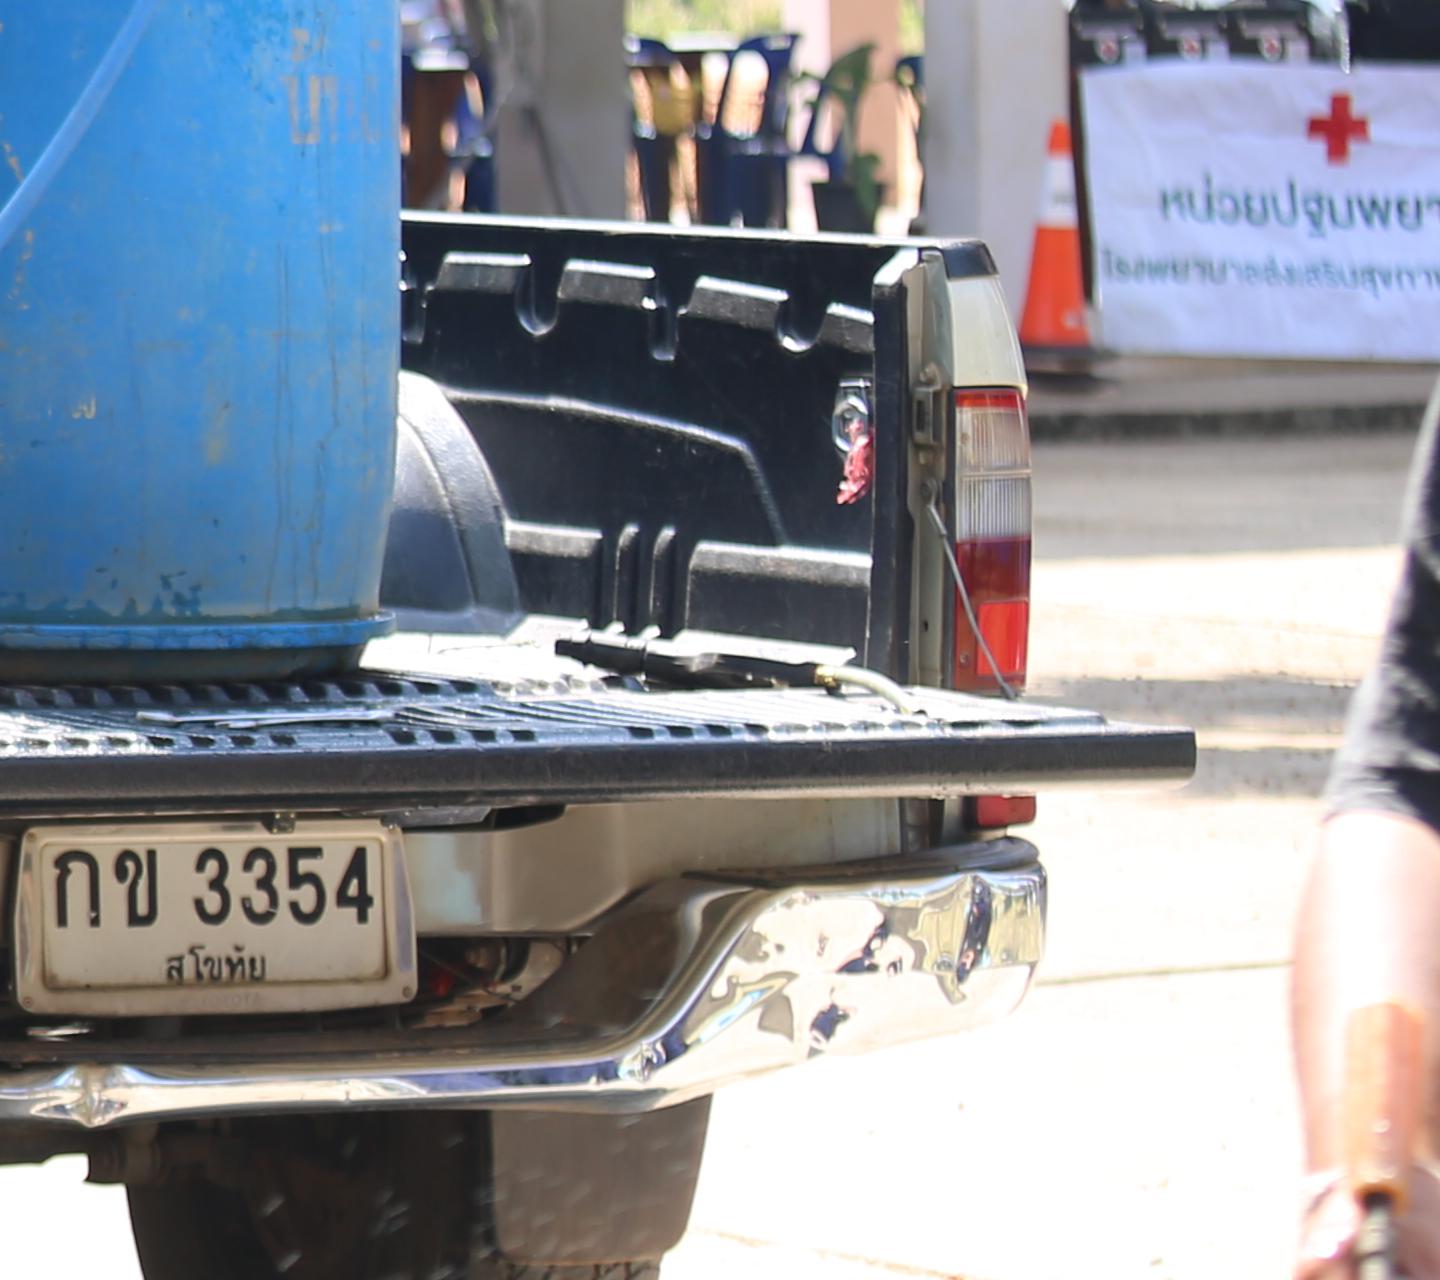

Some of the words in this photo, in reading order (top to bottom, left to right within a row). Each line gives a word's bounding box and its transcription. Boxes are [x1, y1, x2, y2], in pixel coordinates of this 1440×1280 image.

[53, 847, 159, 929] กข
[193, 846, 374, 926] 3354
[166, 944, 266, 985] สโขทัย
